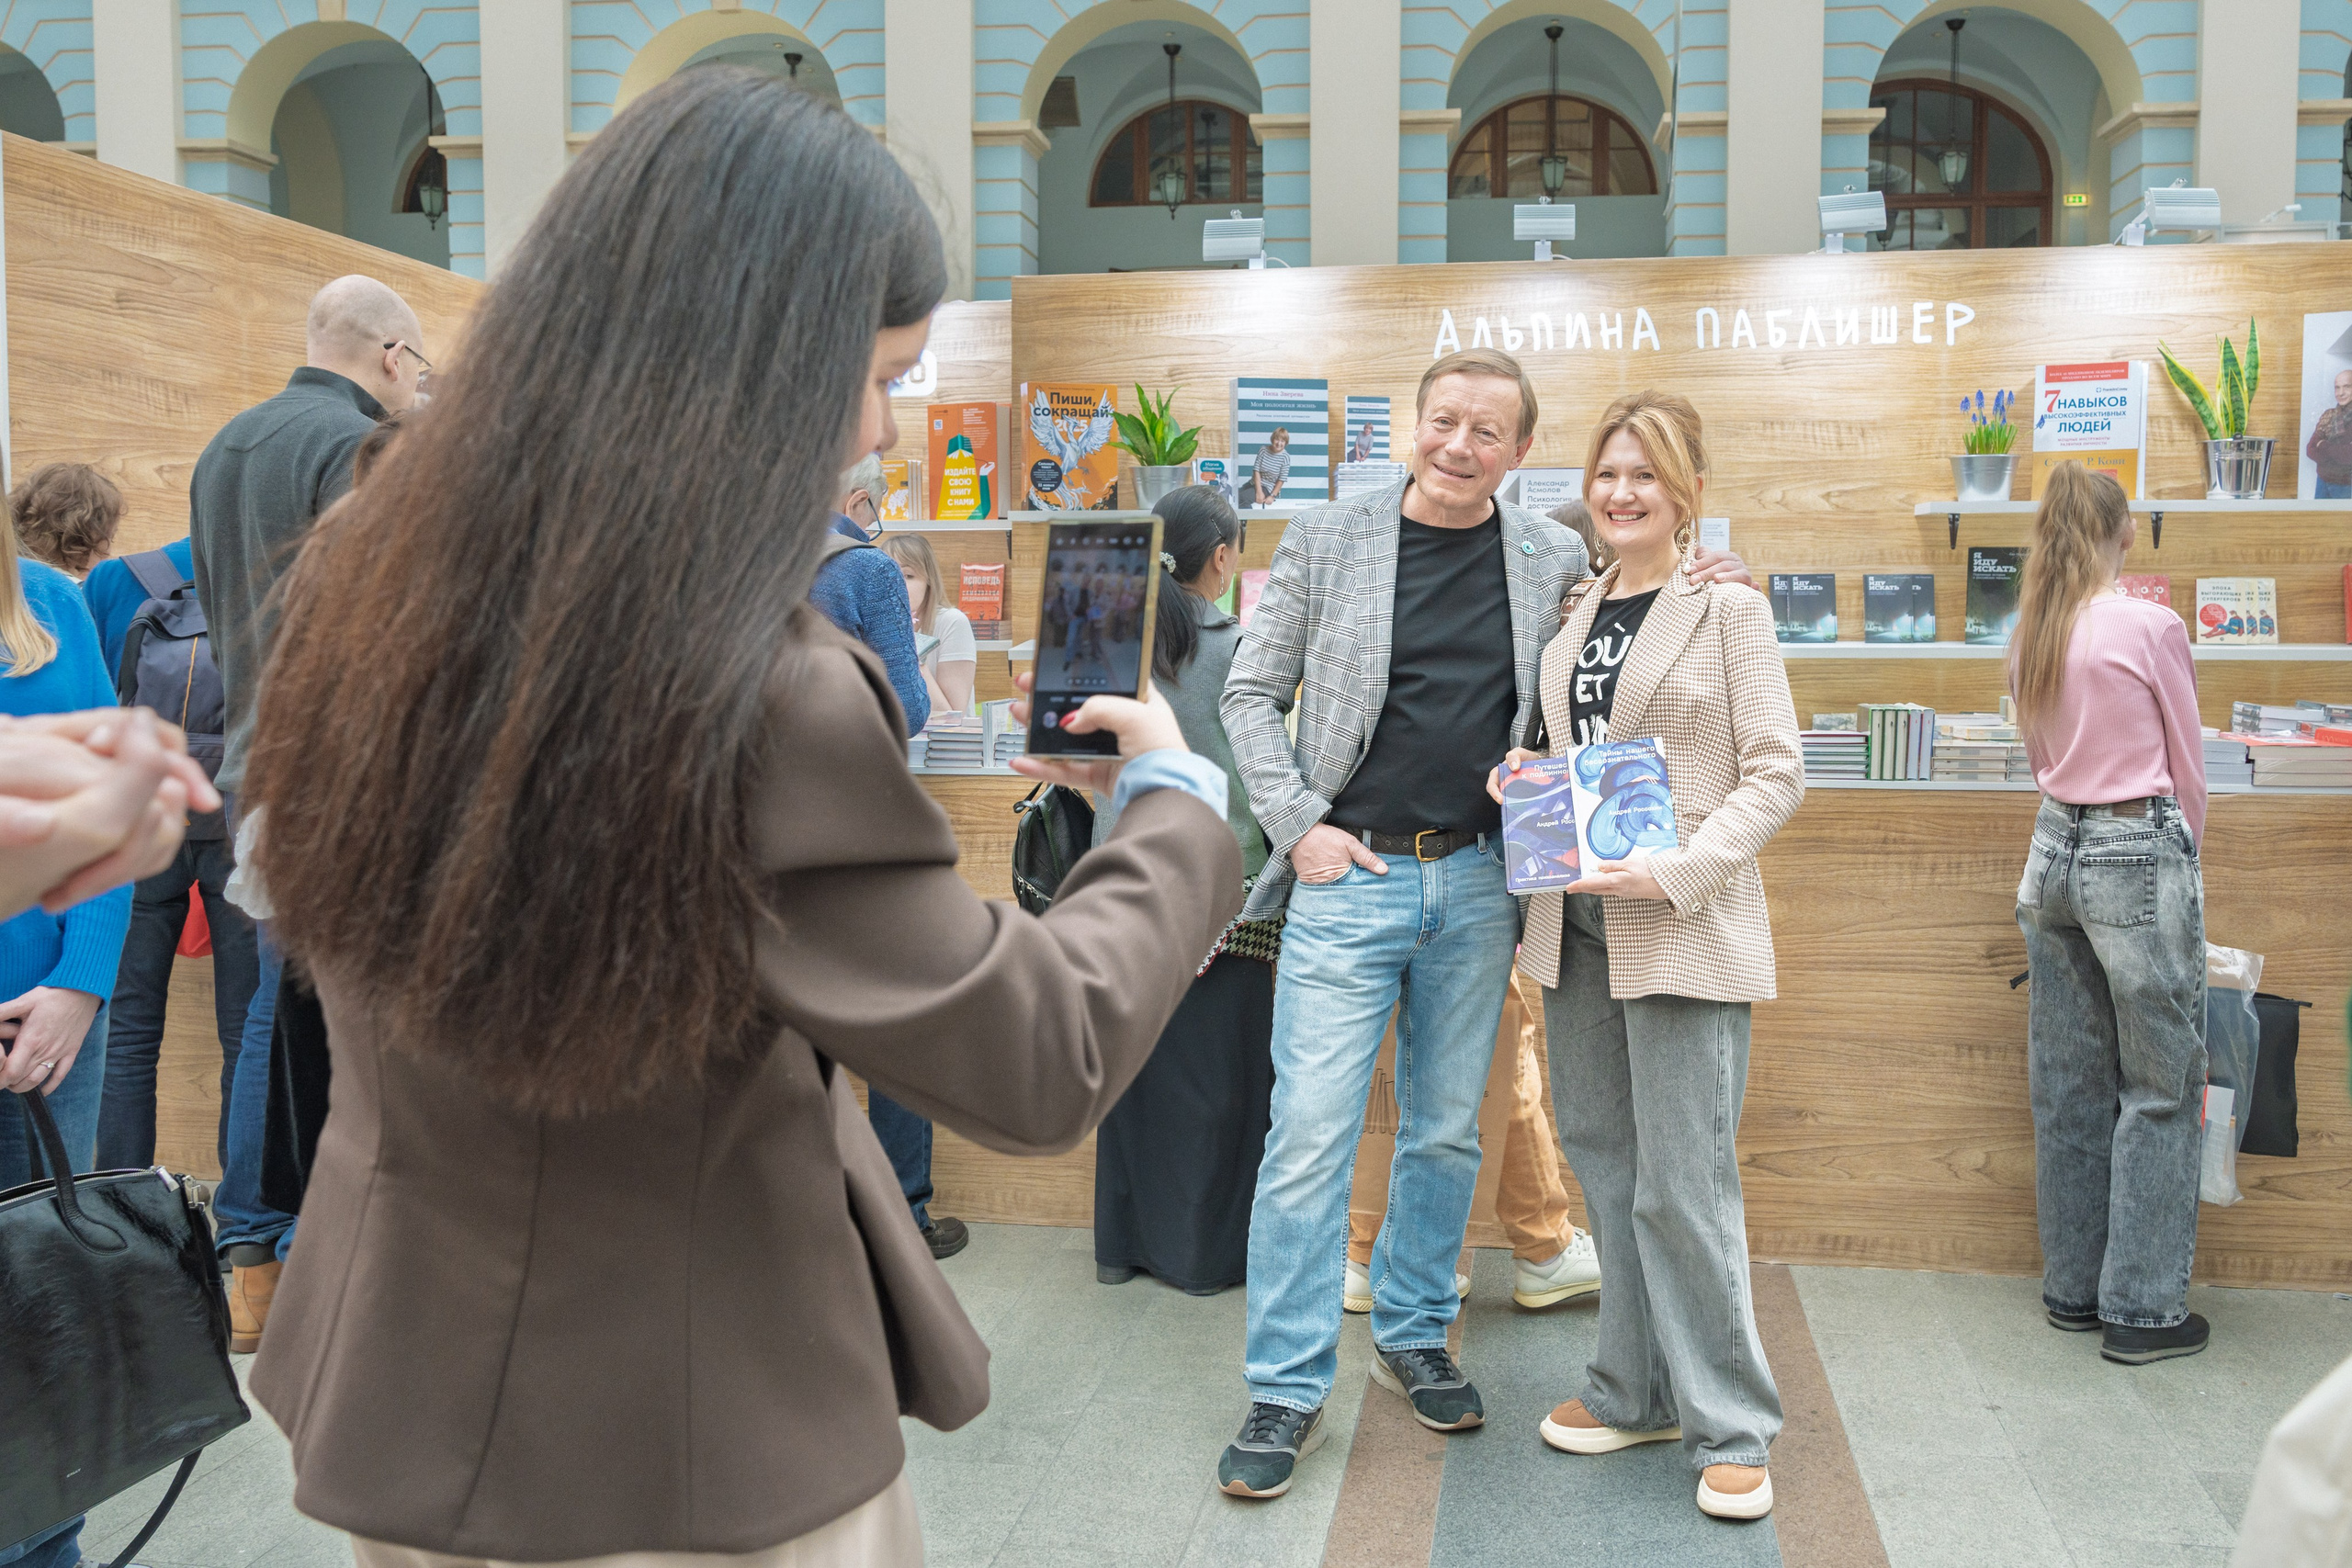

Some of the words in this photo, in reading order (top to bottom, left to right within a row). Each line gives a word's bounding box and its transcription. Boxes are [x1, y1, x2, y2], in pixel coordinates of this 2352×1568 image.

[1433, 308, 1660, 359] АЛЬПИНА
[1696, 301, 1975, 349] ПАБЛИШЕР
[1050, 392, 1097, 407] Пиши,
[2044, 389, 2061, 412] 7
[2058, 396, 2128, 409] НАВЫКОВ
[1034, 405, 1109, 420] сокращай
[2043, 411, 2127, 420] ВЫСОКОЭФФЕКТИВНЫХ
[2057, 418, 2111, 434] ЛЮДЕЙ
[2098, 457, 2125, 466] Кови
[944, 467, 976, 477] ИЗДАЙТЕ
[1527, 479, 1570, 488] Александр
[950, 488, 971, 496] КНИГУ
[963, 576, 1001, 585] ИСПОВЕДЬ
[1577, 622, 1634, 669] OÙ
[1576, 672, 1611, 704] ET
[1584, 752, 1657, 766] бессознательного
[1599, 749, 1623, 759] Тайны
[1625, 745, 1656, 755] нашего
[1536, 818, 1559, 828] Андрей
